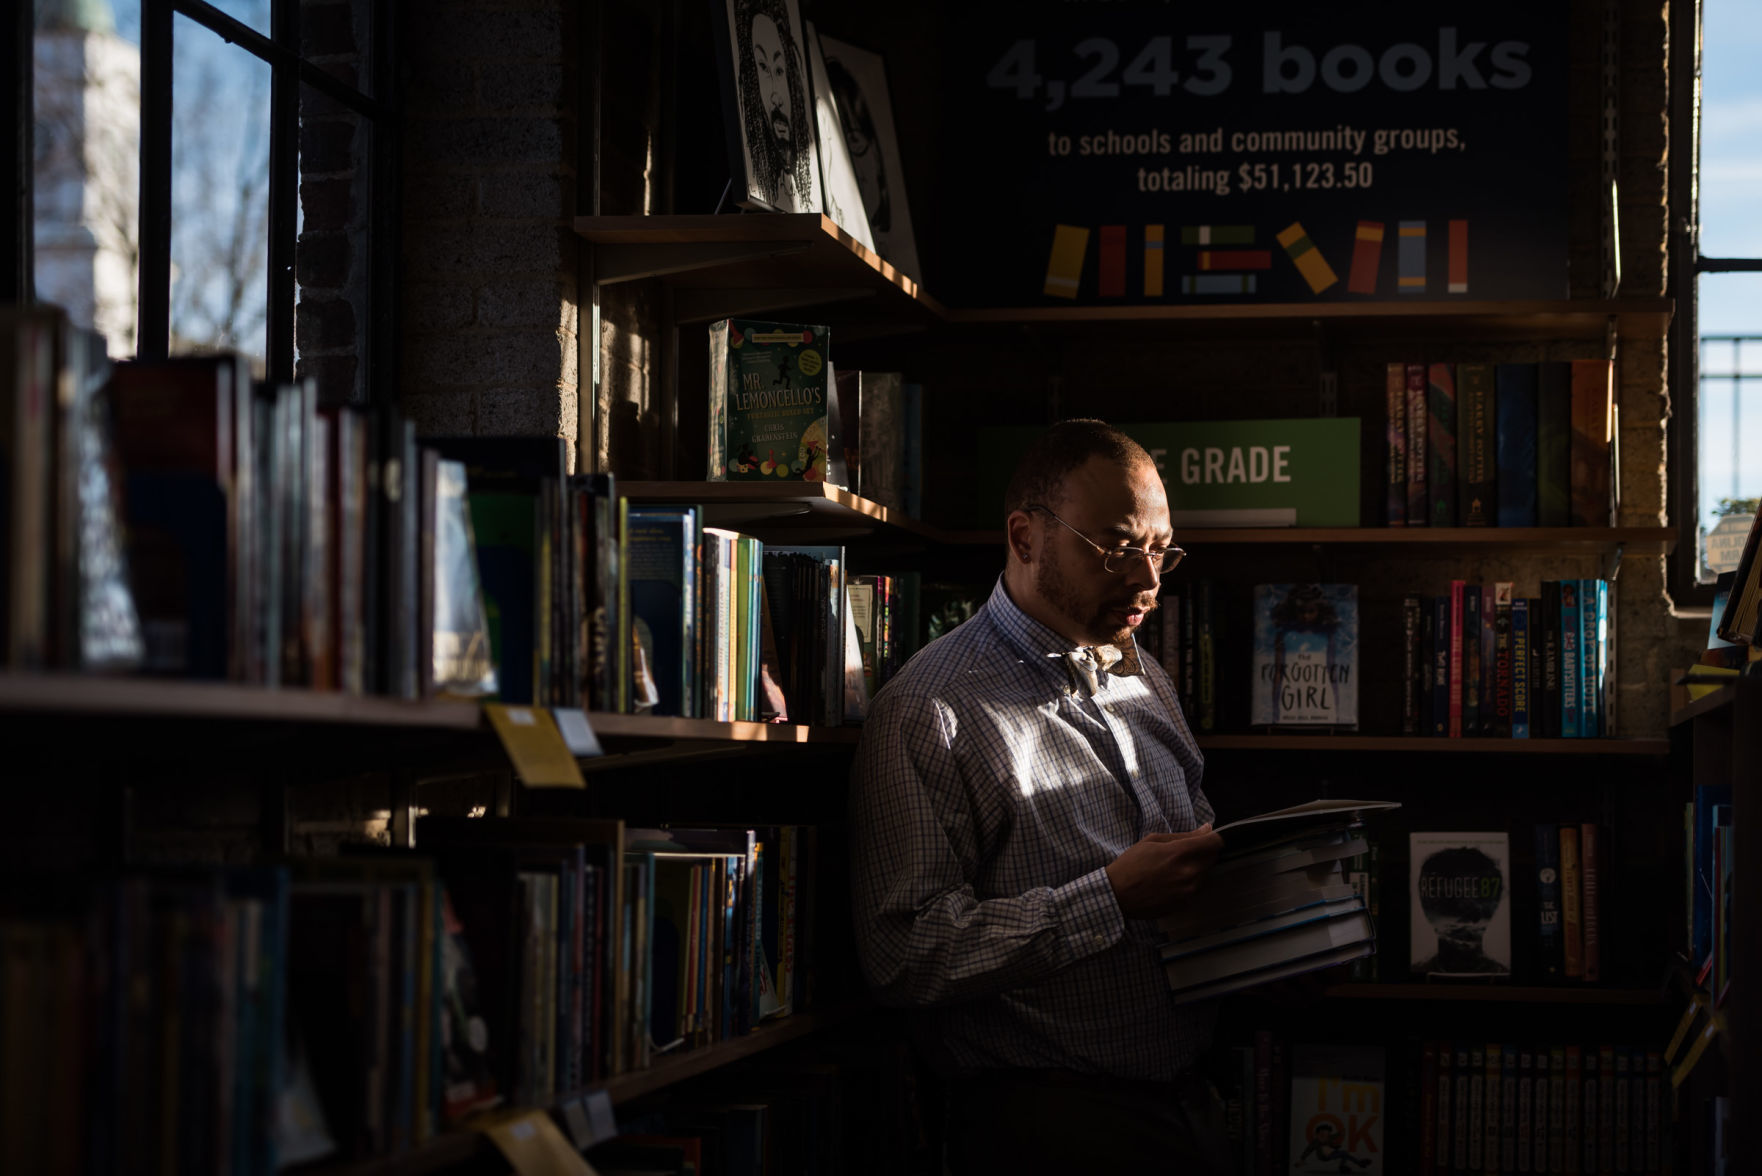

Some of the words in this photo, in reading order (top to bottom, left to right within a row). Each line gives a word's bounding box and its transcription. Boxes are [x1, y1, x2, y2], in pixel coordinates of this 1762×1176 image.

[985, 34, 1234, 112] 4,243
[1262, 26, 1533, 96] books
[1048, 131, 1072, 156] to
[1078, 128, 1172, 156] schools
[1178, 127, 1223, 154] and
[1231, 124, 1366, 155] community
[1373, 126, 1467, 156] groups,
[1137, 166, 1231, 196] totaling
[1238, 161, 1374, 194] $51,123.50
[736, 386, 822, 411] LEMONCELLO'S
[743, 372, 766, 391] MR.
[1415, 390, 1425, 434] HARRY
[1475, 391, 1484, 436] HARRY
[1181, 445, 1292, 485] GRADE
[1415, 437, 1425, 482] POTTER
[1475, 439, 1484, 482] POTTER
[1584, 596, 1595, 607] A
[1498, 633, 1508, 649] THE
[1583, 611, 1596, 648] DROP
[1260, 661, 1350, 685] FORGOTTEN
[1514, 638, 1525, 680] PERFECT
[1281, 684, 1331, 711] GIRL
[1497, 650, 1509, 717] TORNADO
[1514, 681, 1525, 712] SCORE
[1563, 651, 1575, 708] BABYSITTERS
[1583, 675, 1596, 713] HOPE
[1421, 875, 1479, 899] REFUGEE
[1480, 876, 1501, 899] 87
[1540, 910, 1558, 925] LIST
[1317, 1074, 1380, 1112] I'm
[1305, 1112, 1379, 1153] OK
